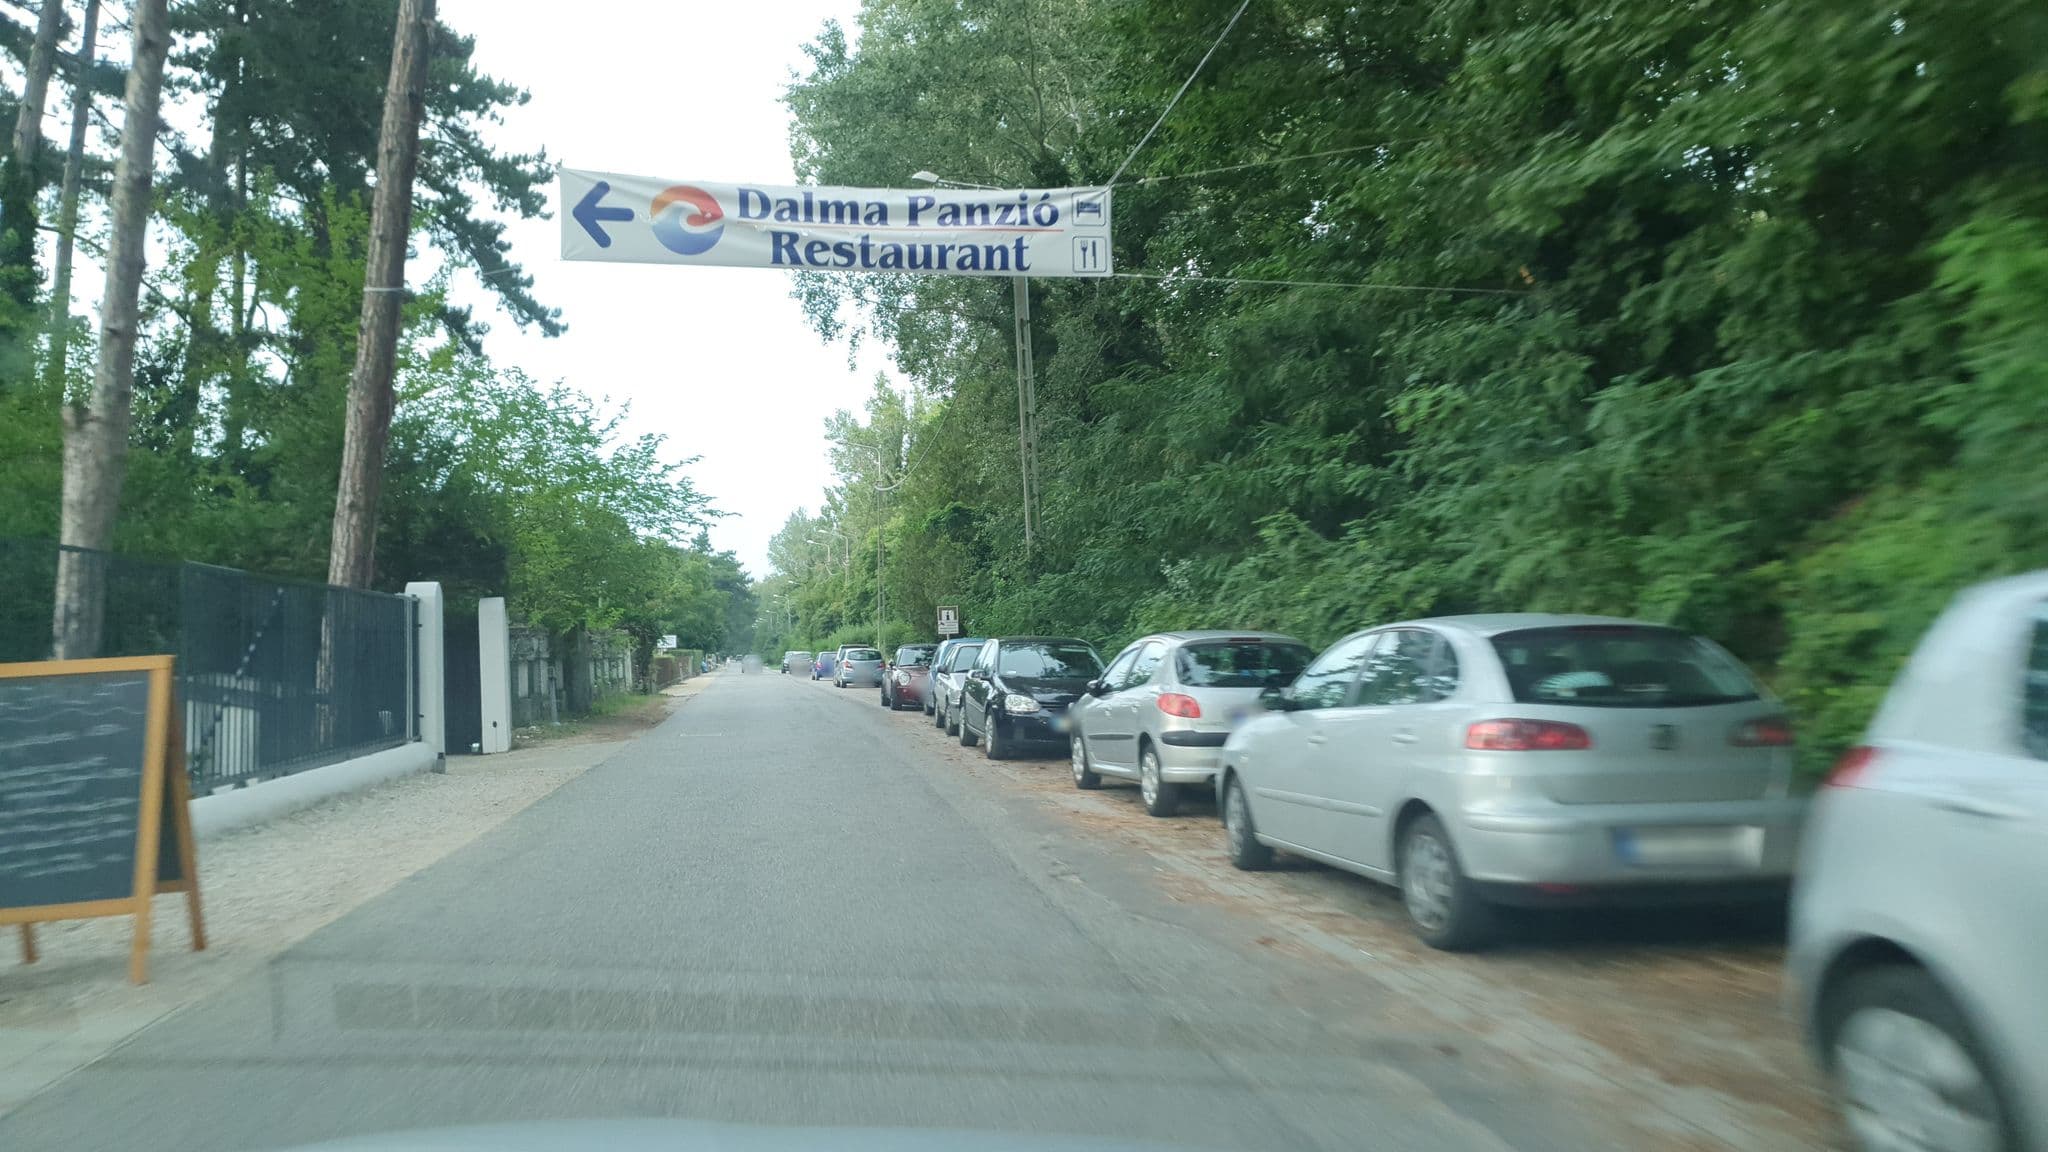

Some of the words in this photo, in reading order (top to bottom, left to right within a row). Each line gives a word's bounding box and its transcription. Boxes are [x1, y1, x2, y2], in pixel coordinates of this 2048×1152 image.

[737, 187, 890, 226] Dalma
[906, 192, 1061, 227] Panzió
[770, 230, 1032, 272] Restaurant
